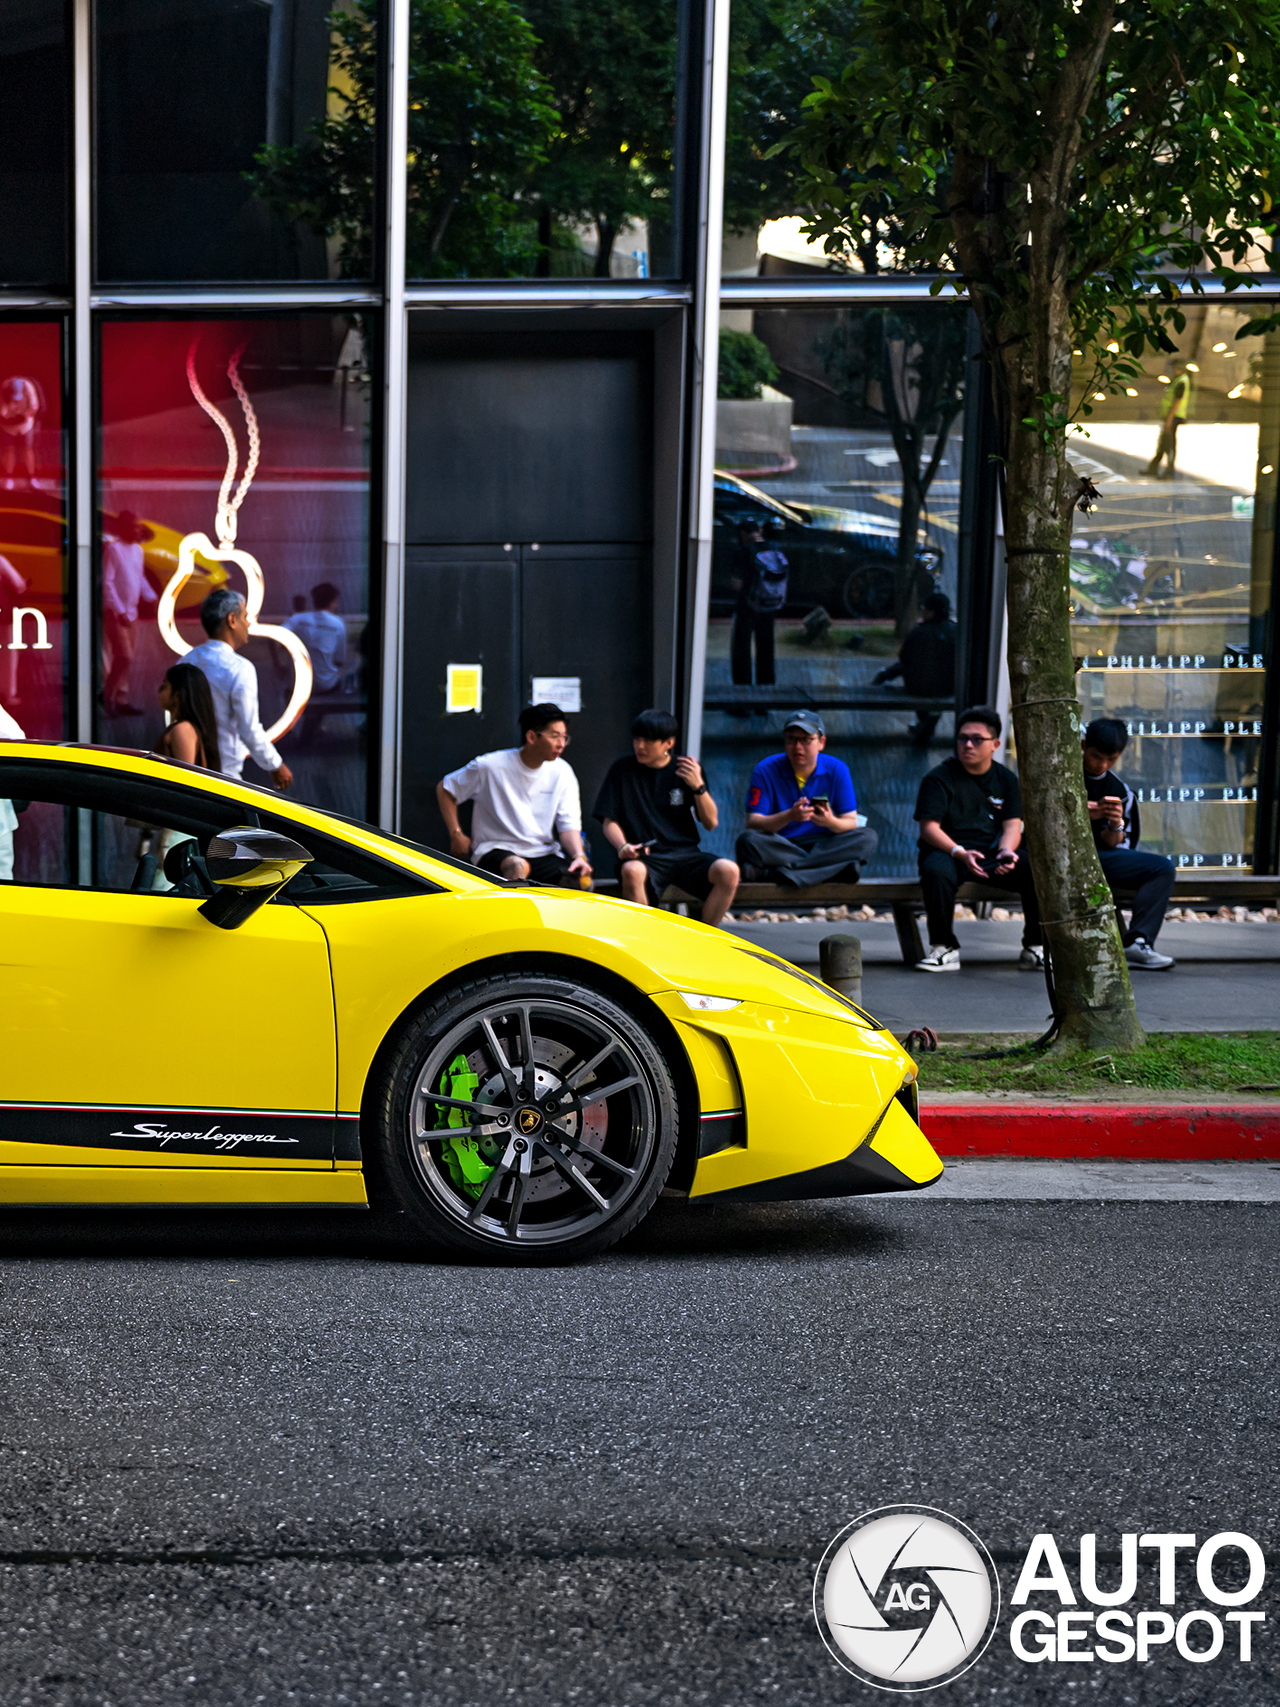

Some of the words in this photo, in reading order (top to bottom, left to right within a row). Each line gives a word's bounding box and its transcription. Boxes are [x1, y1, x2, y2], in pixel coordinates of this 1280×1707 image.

[1107, 654, 1206, 669] PHILIPP
[748, 787, 762, 806] 3
[110, 1123, 300, 1149] Superleggera
